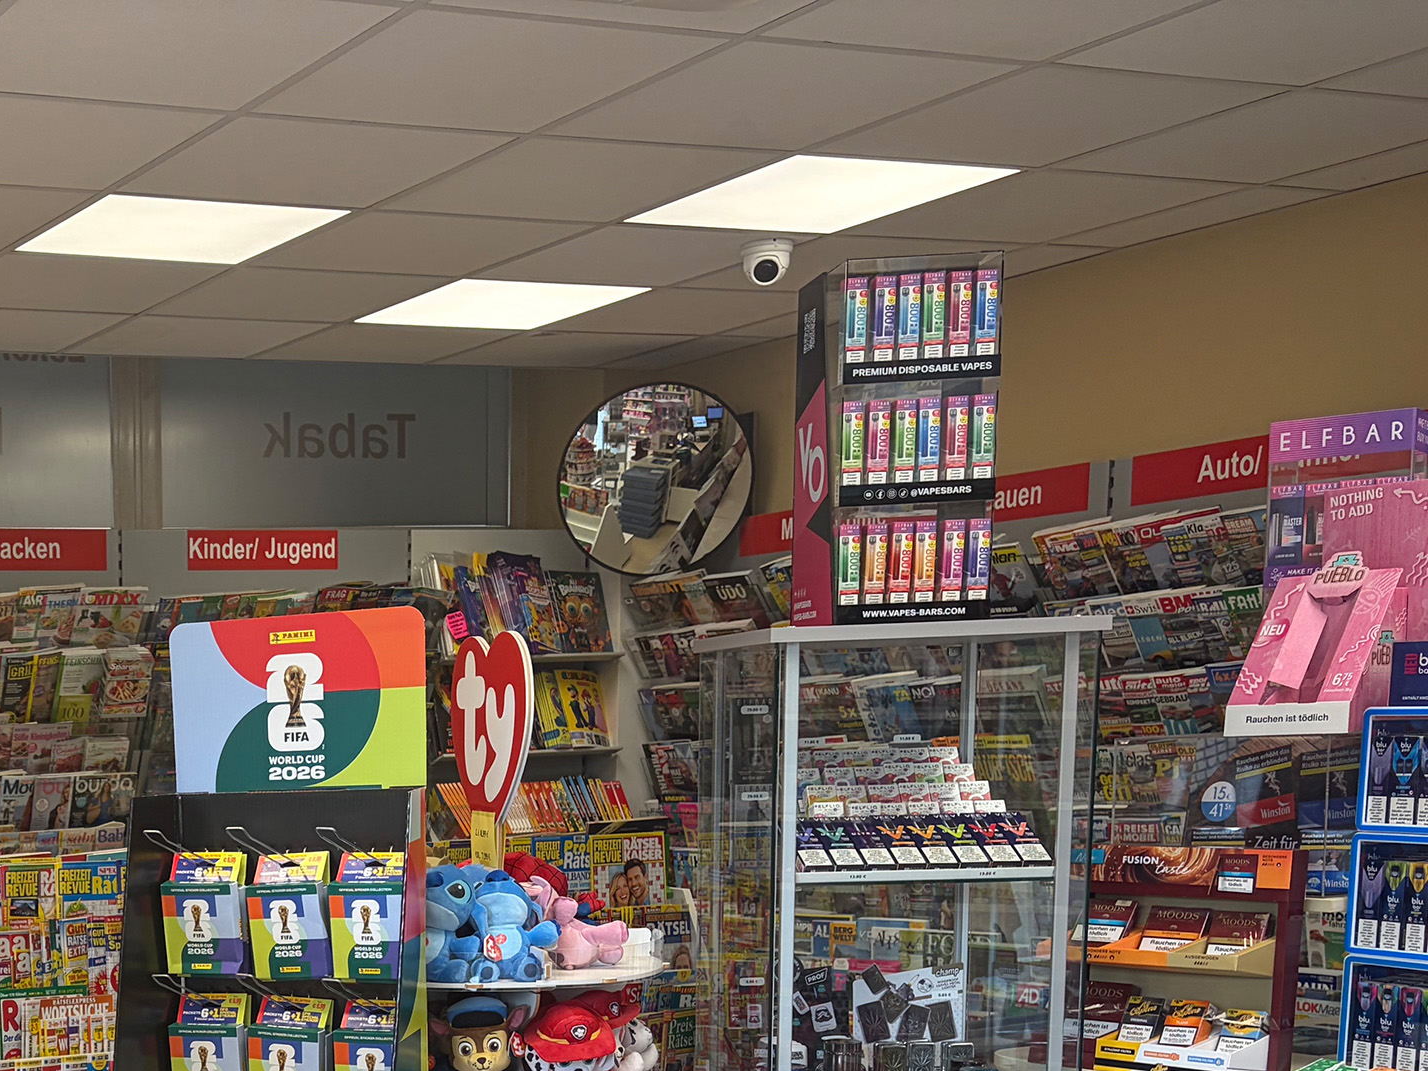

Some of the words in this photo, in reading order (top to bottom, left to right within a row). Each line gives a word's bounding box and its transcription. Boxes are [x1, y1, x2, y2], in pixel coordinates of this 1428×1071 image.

[853, 367, 897, 378] PREMIUM
[899, 363, 959, 375] DISPOSABLE
[961, 361, 992, 371] VAPES
[1279, 421, 1404, 452] ELFBAR
[1197, 446, 1263, 483] Auto/
[910, 485, 972, 498] @VAPESBARS
[994, 483, 1041, 511] auen
[1330, 488, 1383, 508] NOTHING
[1330, 509, 1345, 522] TO
[1348, 504, 1373, 518] ADD
[189, 538, 258, 561] Kinder/
[265, 538, 336, 563] Jugend
[1314, 566, 1365, 584] PUEBLO
[717, 584, 746, 600] UDO
[862, 606, 965, 619] WWW.VAPES-BARS.COM
[283, 631, 314, 641] PANINI
[1259, 624, 1287, 638] NEU
[1246, 714, 1281, 724] Rauchen
[1285, 714, 1295, 723] ist
[1298, 712, 1328, 723] tödlich
[455, 651, 515, 802] ty
[284, 732, 309, 742] FIFA
[268, 755, 304, 765] WORLD
[306, 754, 325, 765] CUP
[268, 766, 325, 781] 2026
[75, 777, 133, 792] burda
[1261, 805, 1291, 819] Winston
[593, 839, 622, 851] FREIZEIT
[624, 837, 661, 850] RÄTSEL
[1254, 835, 1278, 849] Zeit
[1281, 835, 1298, 849] für
[593, 851, 622, 864] REVUE
[624, 850, 663, 861] KAISER
[1122, 855, 1159, 866] FUSION
[1155, 858, 1192, 875] taste
[6, 870, 38, 885] FREIZEIT
[5, 884, 38, 897] REVUE
[1156, 909, 1200, 921] MOODS
[1222, 917, 1257, 927] MOODS
[935, 967, 960, 978] champ
[41, 1003, 109, 1019] WORTSUCHE
